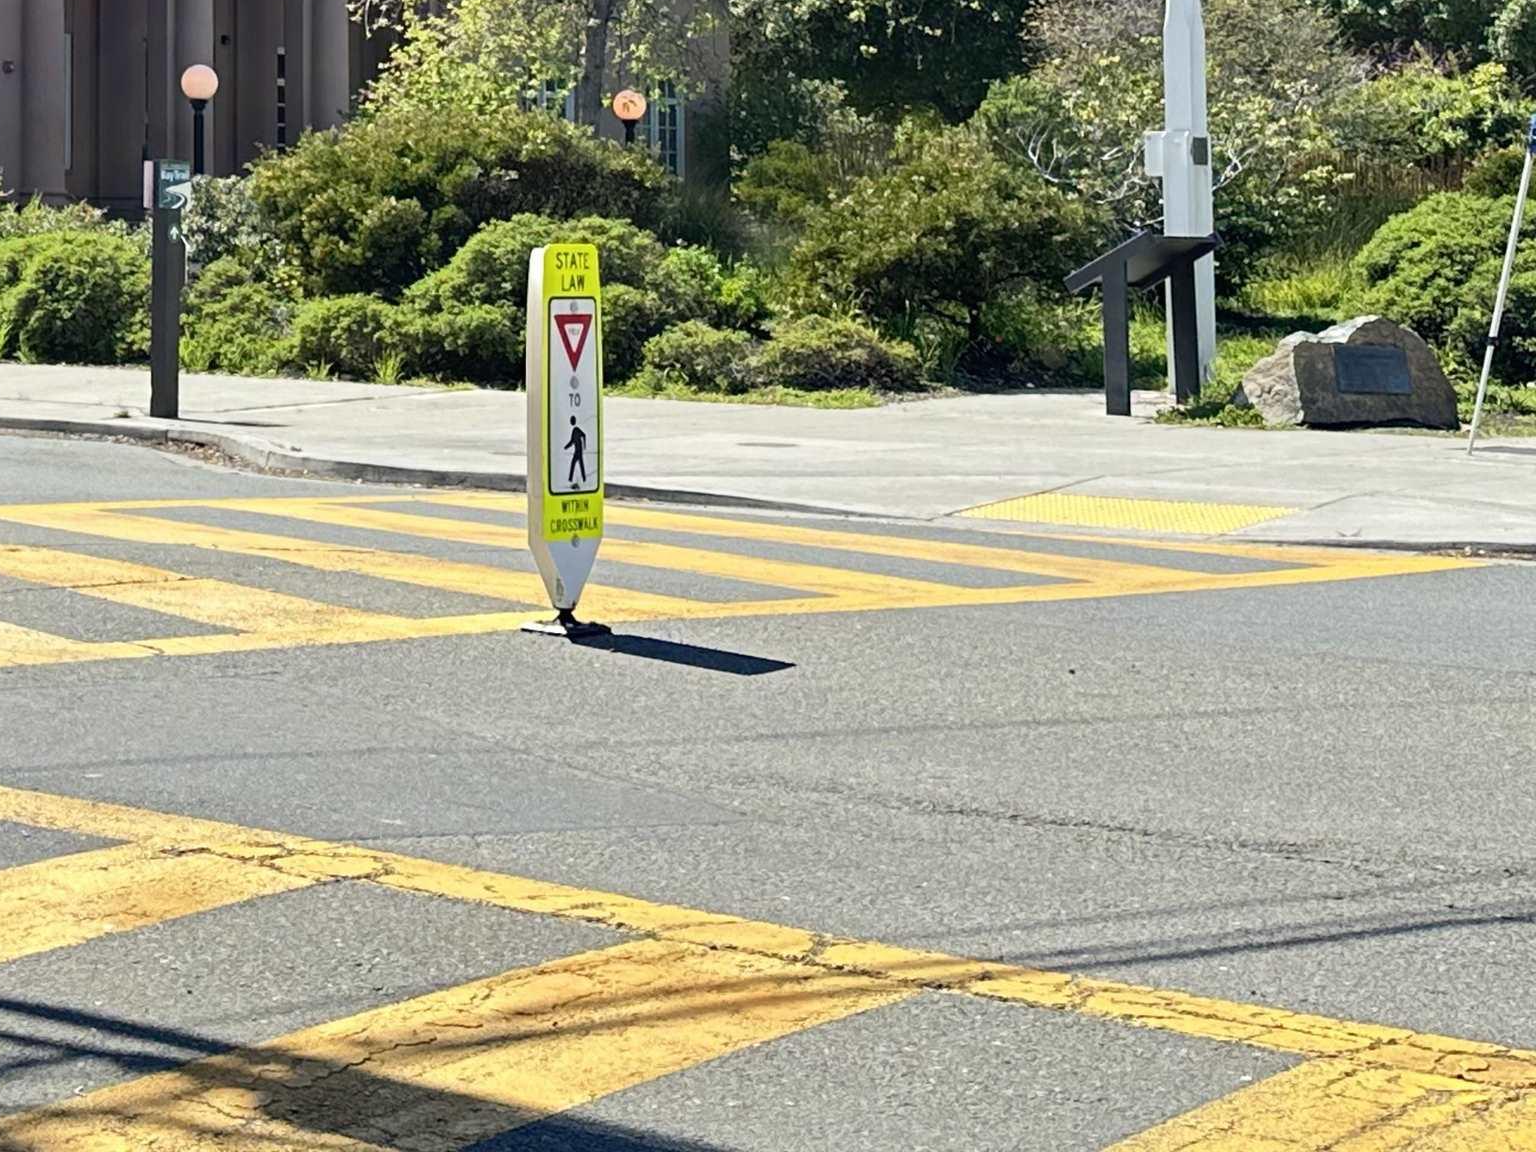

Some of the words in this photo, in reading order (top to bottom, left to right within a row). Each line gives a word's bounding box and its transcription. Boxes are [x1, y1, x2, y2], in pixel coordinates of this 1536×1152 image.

[555, 251, 590, 270] STATE
[561, 275, 585, 292] LAW
[568, 393, 581, 407] TO
[561, 499, 589, 513] WITHIN
[550, 517, 598, 533] CROSSWALK
